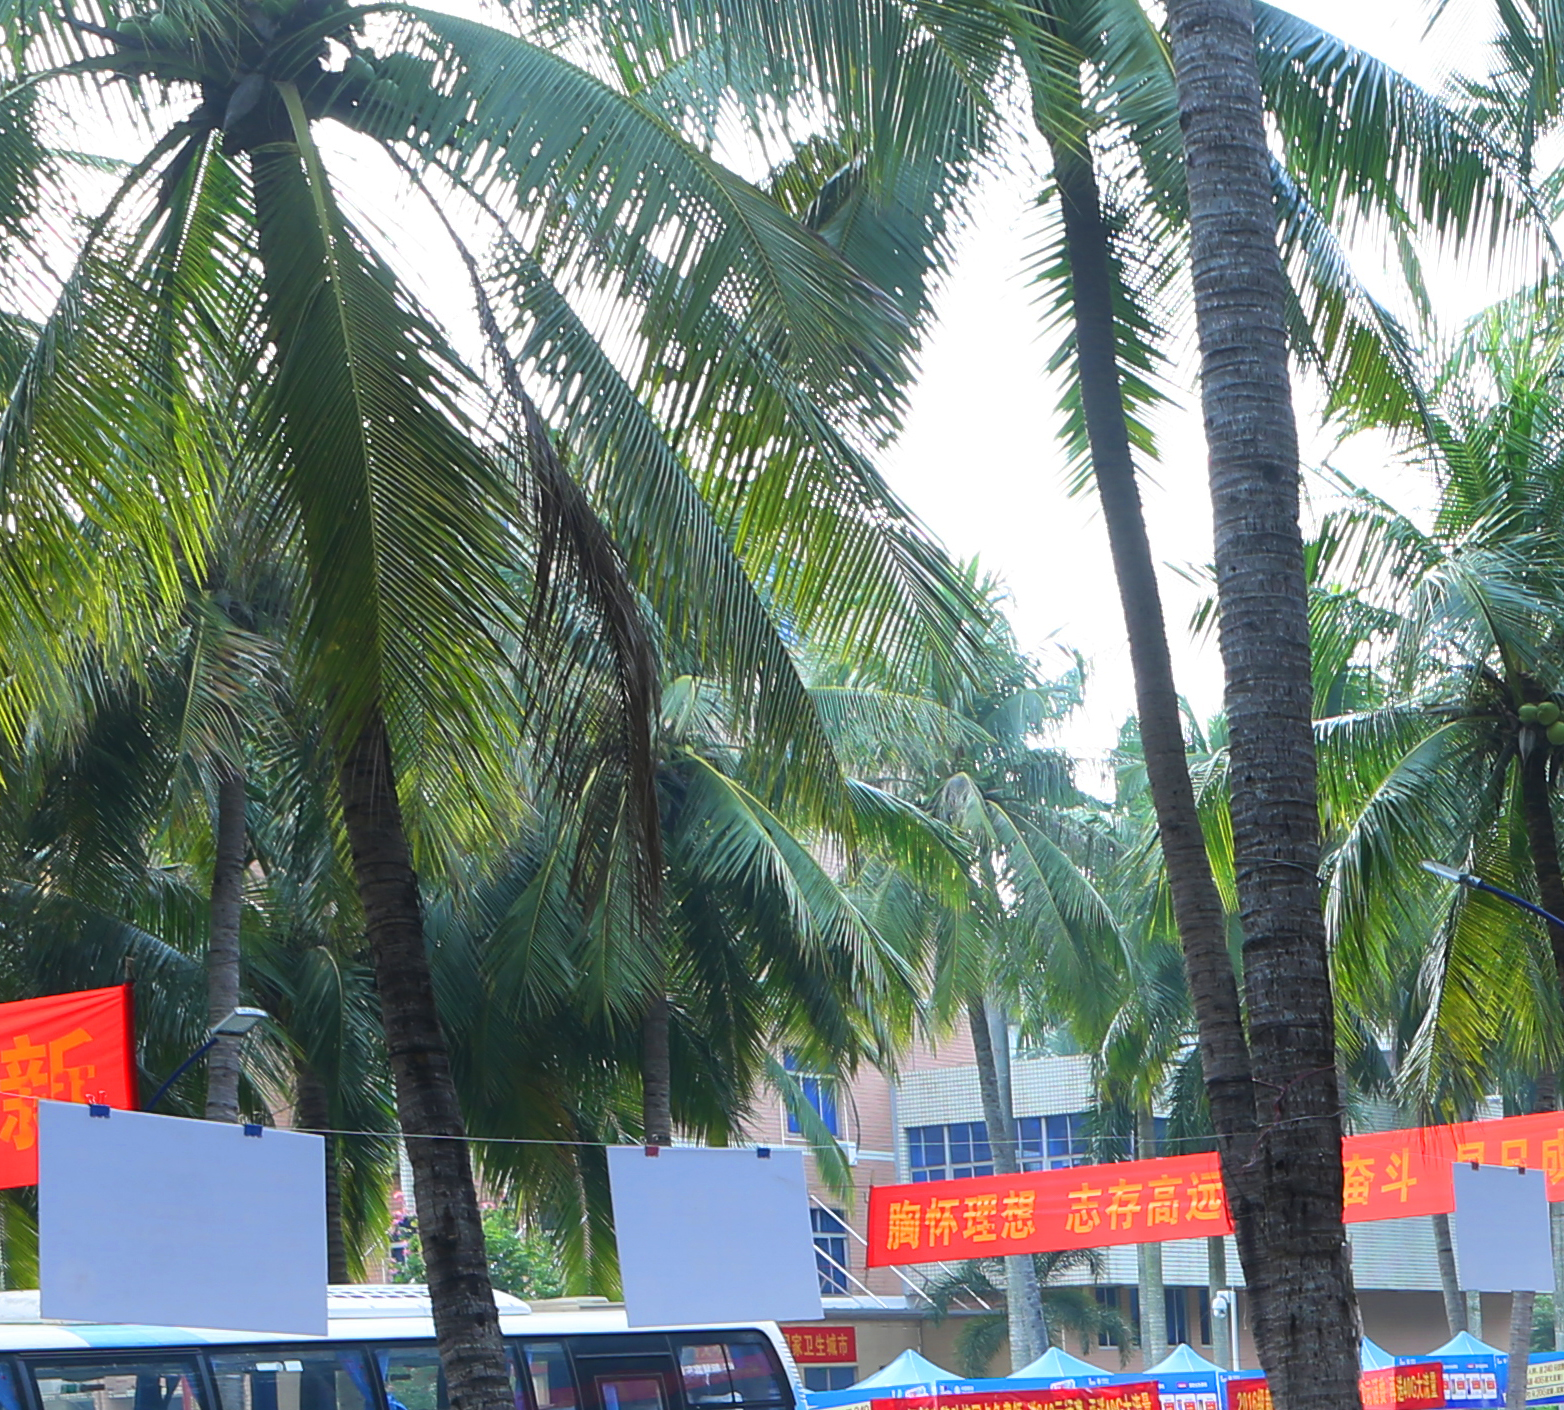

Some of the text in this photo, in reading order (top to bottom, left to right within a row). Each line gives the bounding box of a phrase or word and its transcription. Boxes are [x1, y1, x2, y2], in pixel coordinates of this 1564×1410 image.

[0, 1028, 93, 1150] 新
[887, 1188, 1038, 1251] 胸怀理想
[1064, 1170, 1224, 1234] 志存高远
[1343, 1151, 1419, 1210] 奋斗
